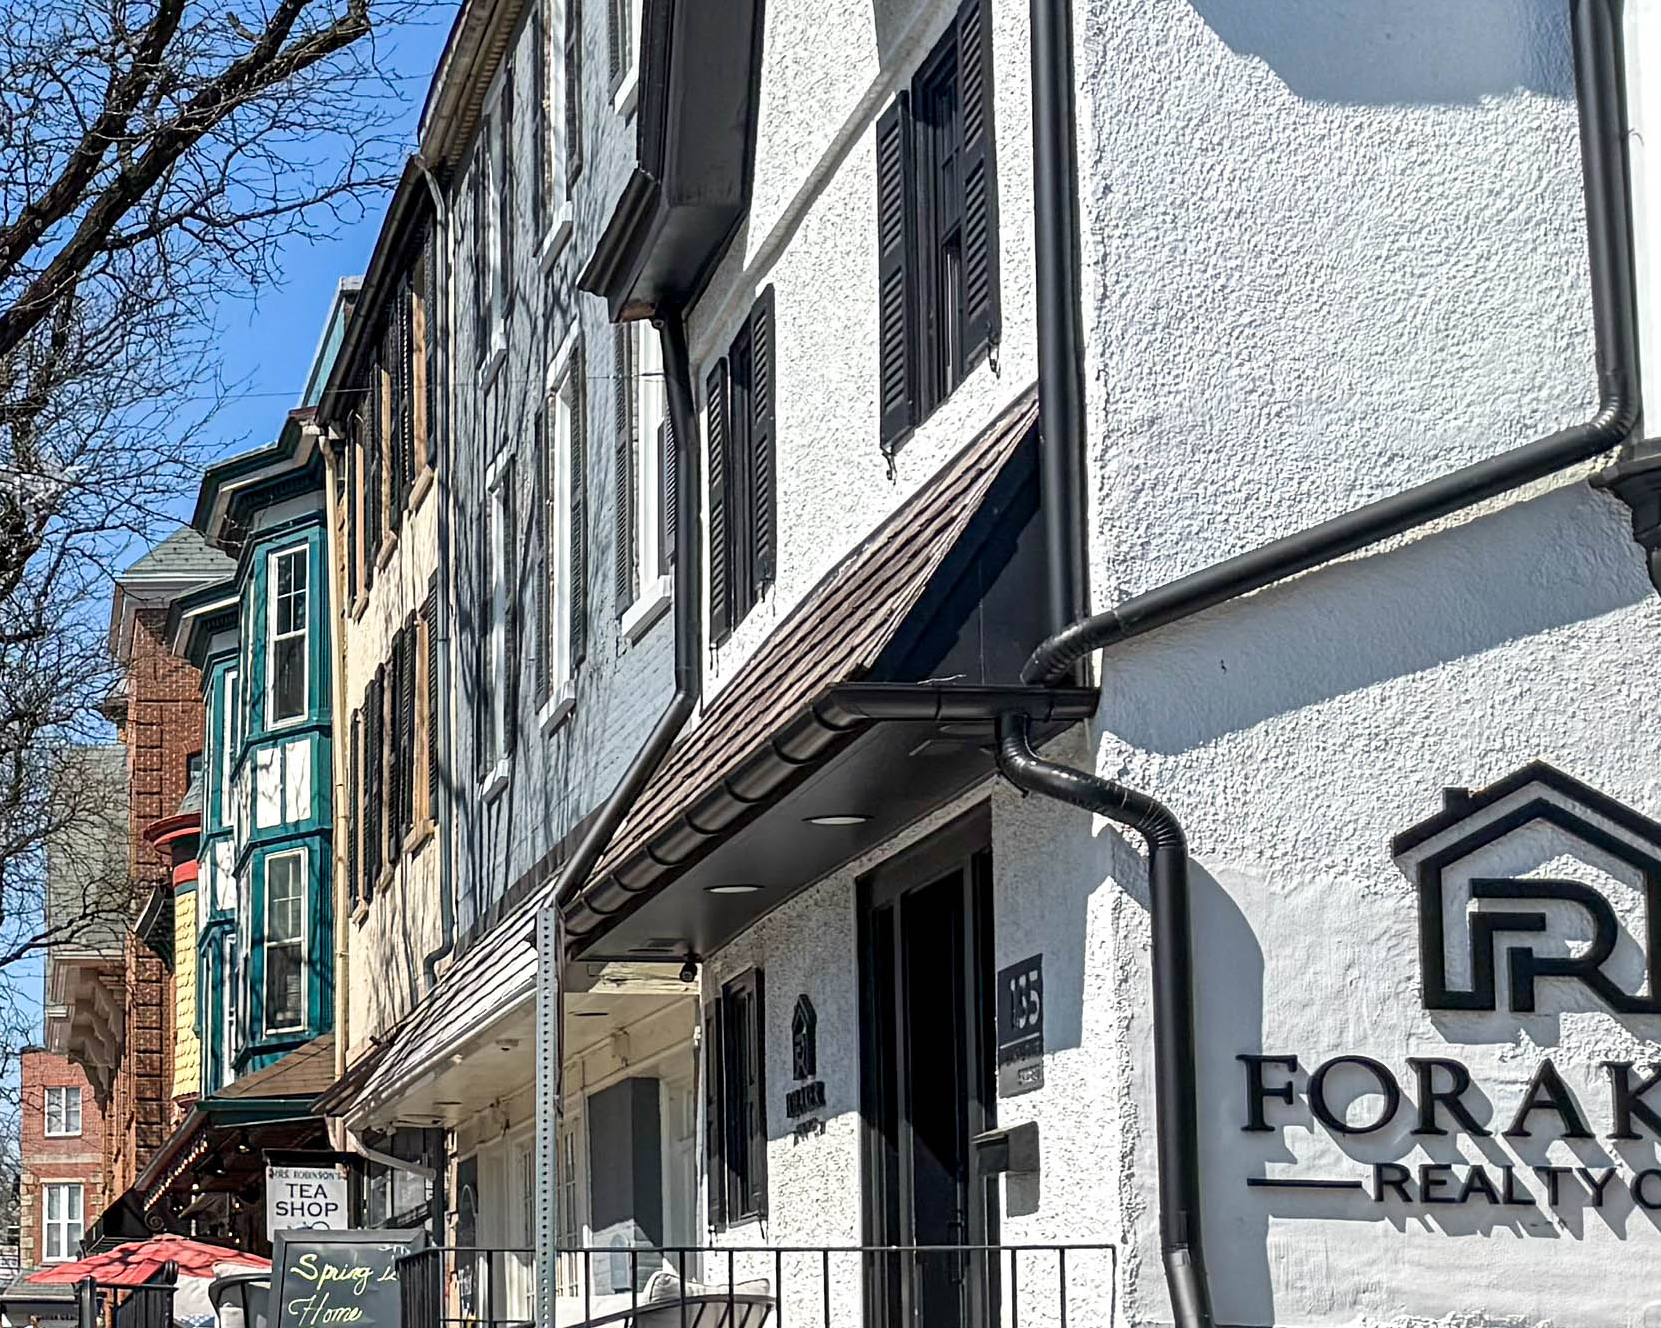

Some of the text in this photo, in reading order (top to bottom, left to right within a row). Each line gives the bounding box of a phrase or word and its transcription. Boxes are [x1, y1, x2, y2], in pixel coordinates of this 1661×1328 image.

[285, 1182, 328, 1199] TEA
[1374, 1162, 1617, 1207] REALTY
[275, 1200, 339, 1217] SHOP
[290, 1253, 373, 1296] Spring
[288, 1292, 363, 1327] Home
